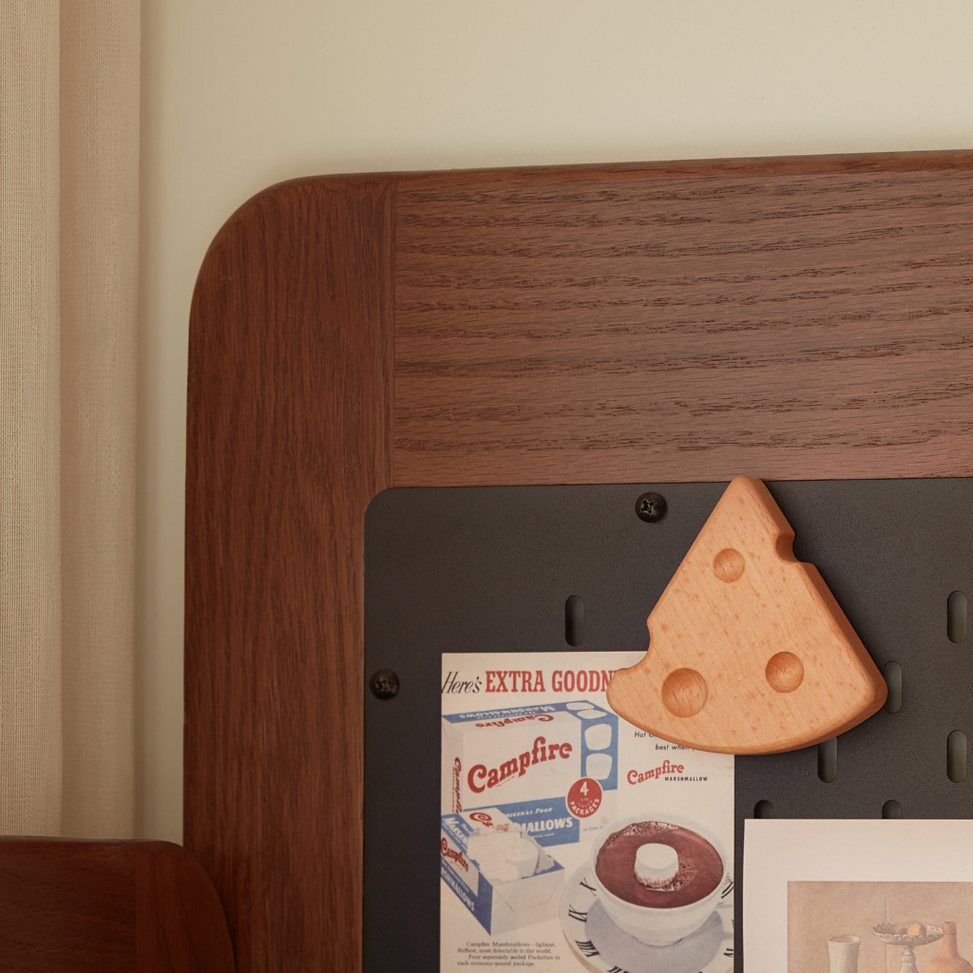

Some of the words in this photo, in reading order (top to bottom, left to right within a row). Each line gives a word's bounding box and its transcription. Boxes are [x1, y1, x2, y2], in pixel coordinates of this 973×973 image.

[441, 672, 482, 694] Here's
[485, 670, 546, 692] EXTRA
[552, 670, 616, 692] GOODN
[468, 736, 572, 794] Campfire
[627, 760, 684, 785] Campfire
[454, 757, 462, 814] Campfi
[580, 781, 589, 796] 4
[570, 798, 600, 815] PACKAGES
